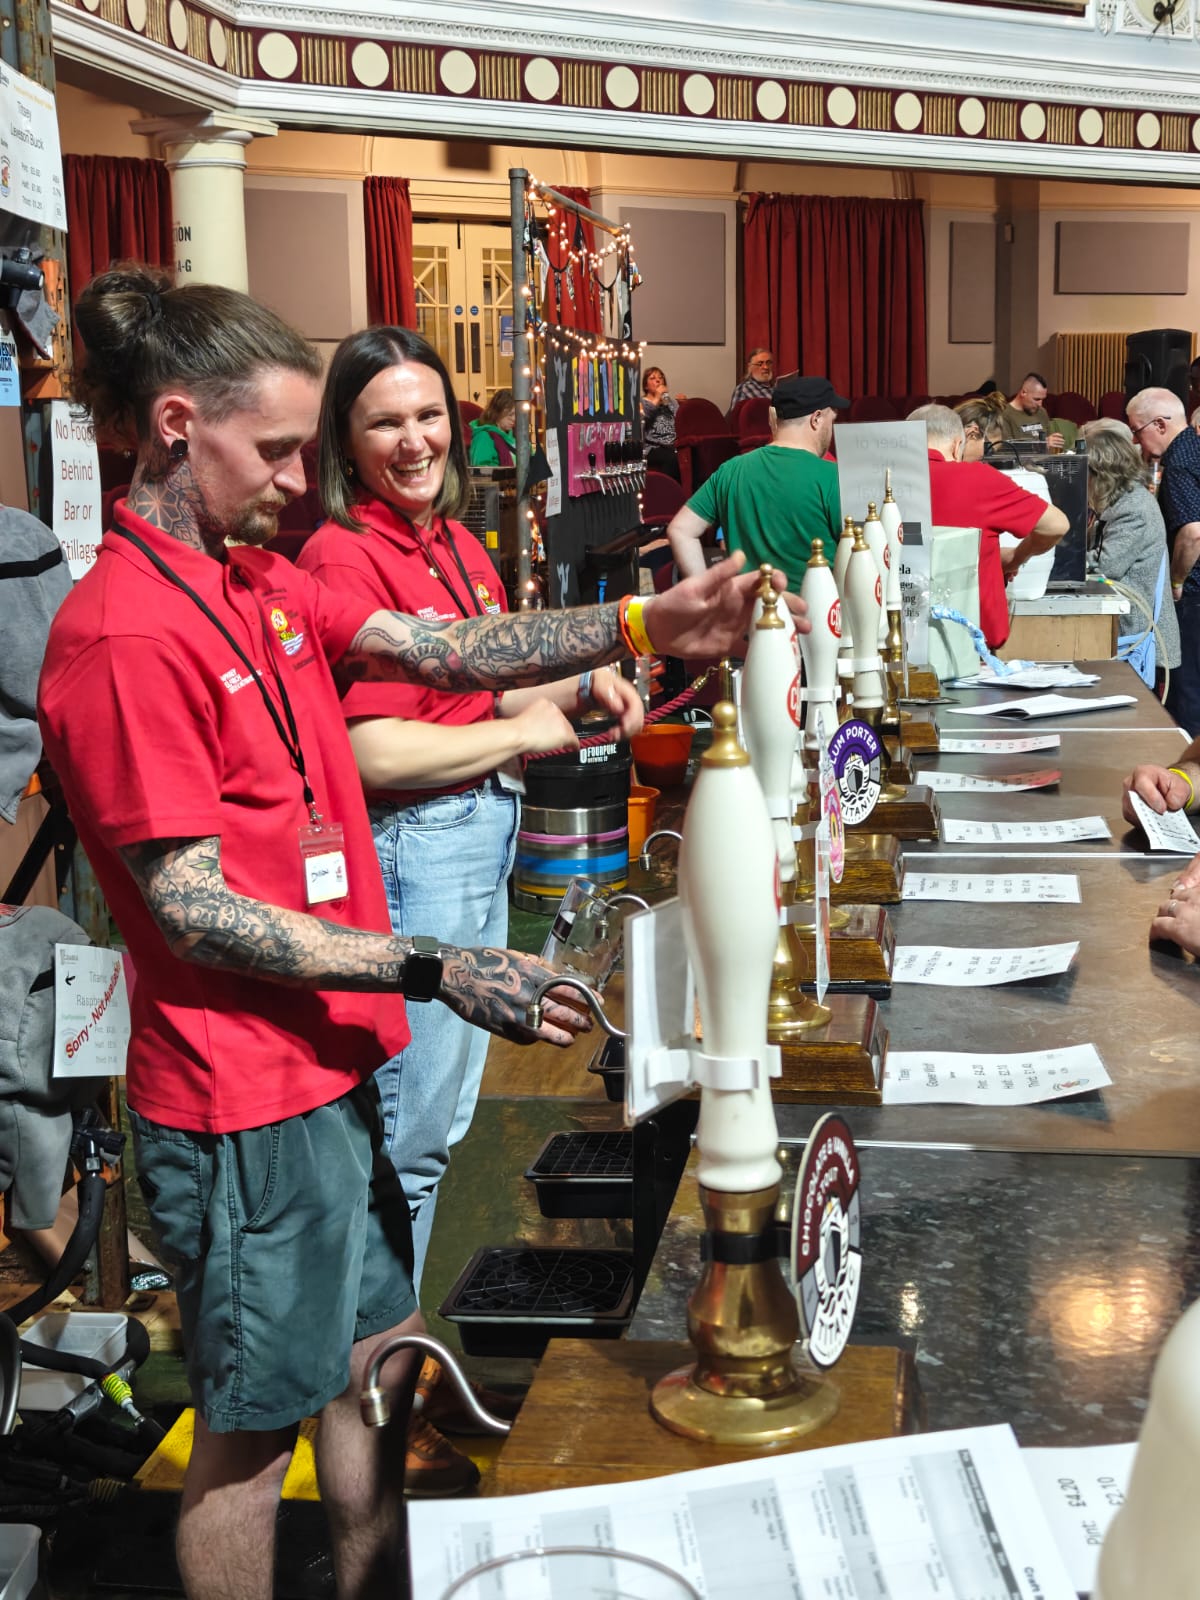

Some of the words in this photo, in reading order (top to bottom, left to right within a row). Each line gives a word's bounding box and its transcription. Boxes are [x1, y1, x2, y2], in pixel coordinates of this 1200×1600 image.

[55, 418, 69, 441] No
[61, 459, 94, 482] Behind
[64, 500, 81, 521] Bar
[82, 505, 93, 521] or
[830, 734, 846, 765] LUM
[845, 726, 878, 754] PORTER
[65, 1024, 90, 1059] Sorry
[91, 999, 108, 1024] Not
[802, 1143, 829, 1257] CHOCOLATE
[816, 1166, 839, 1206] STOUT
[1057, 1478, 1087, 1507] £4.20
[1082, 1519, 1104, 1546] Pint:
